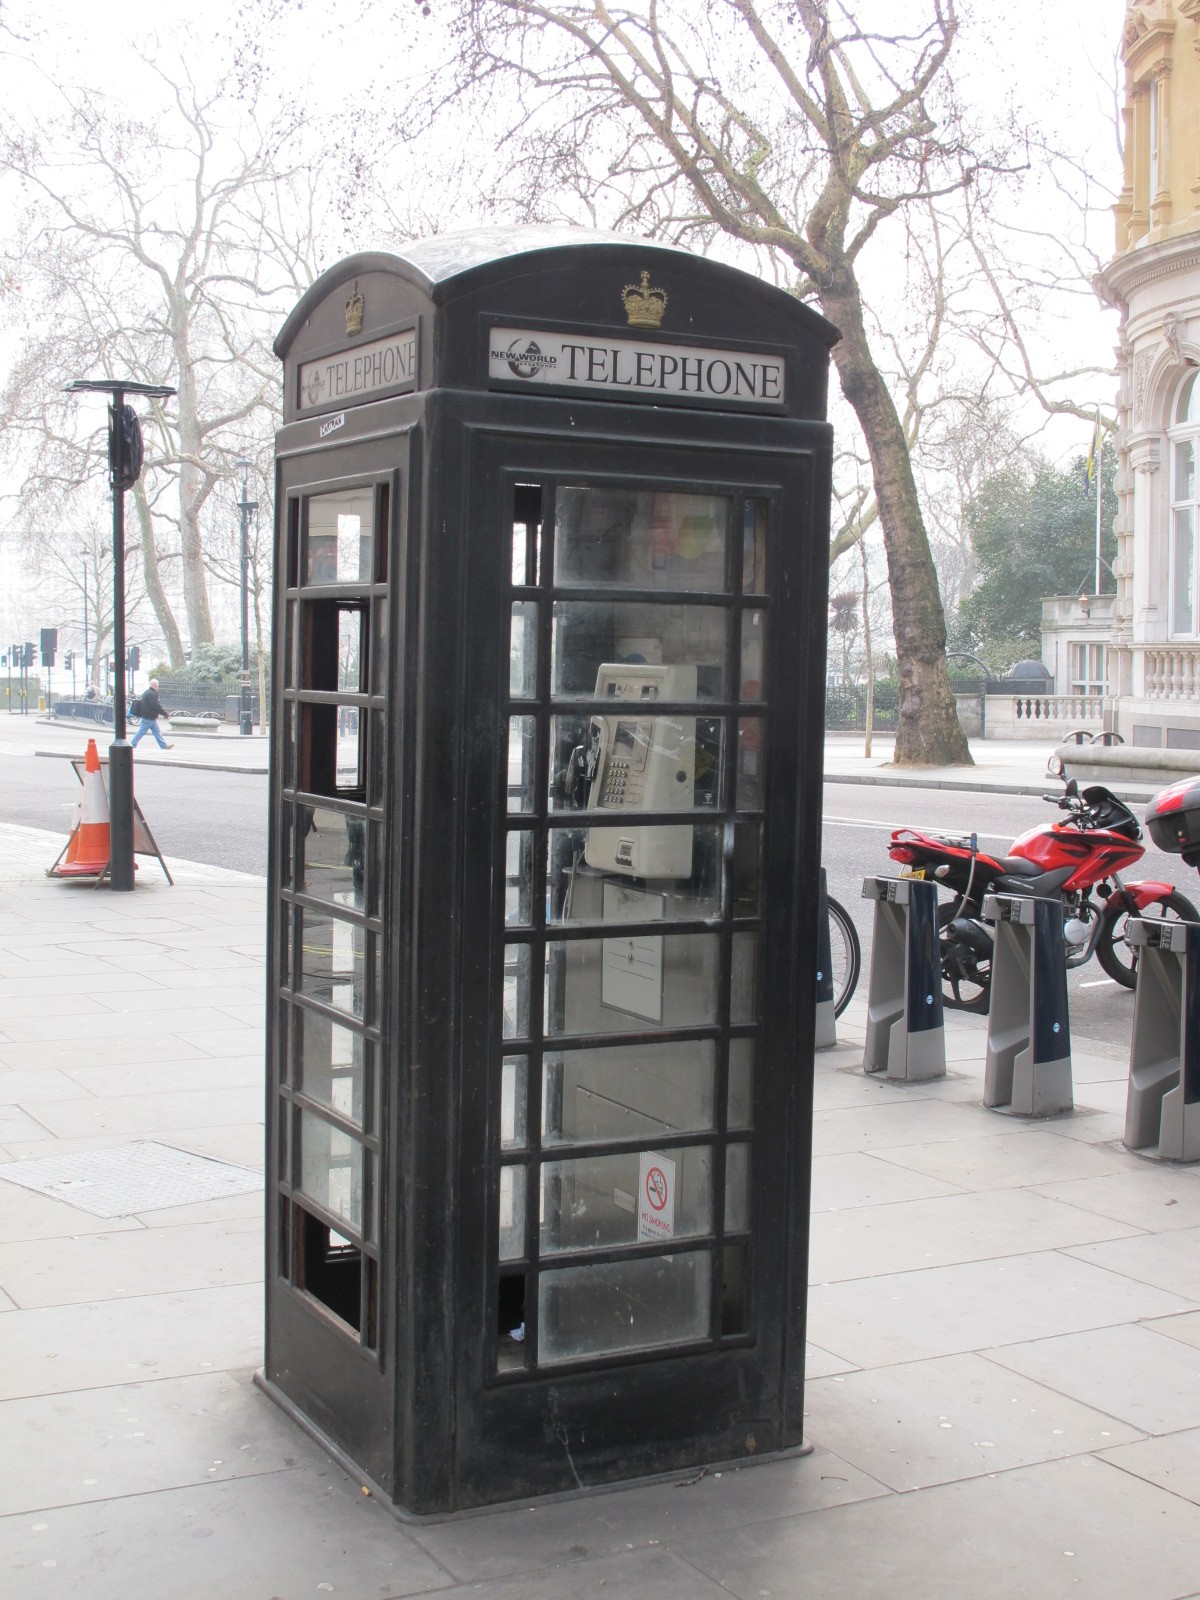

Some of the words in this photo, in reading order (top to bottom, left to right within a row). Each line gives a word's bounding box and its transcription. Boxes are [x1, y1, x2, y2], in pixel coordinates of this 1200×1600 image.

[327, 340, 415, 398] TELEPHONE
[491, 350, 516, 360] NEW
[519, 353, 557, 364] WORLD
[561, 344, 781, 399] TELEPHONE
[641, 1210, 648, 1222] NO
